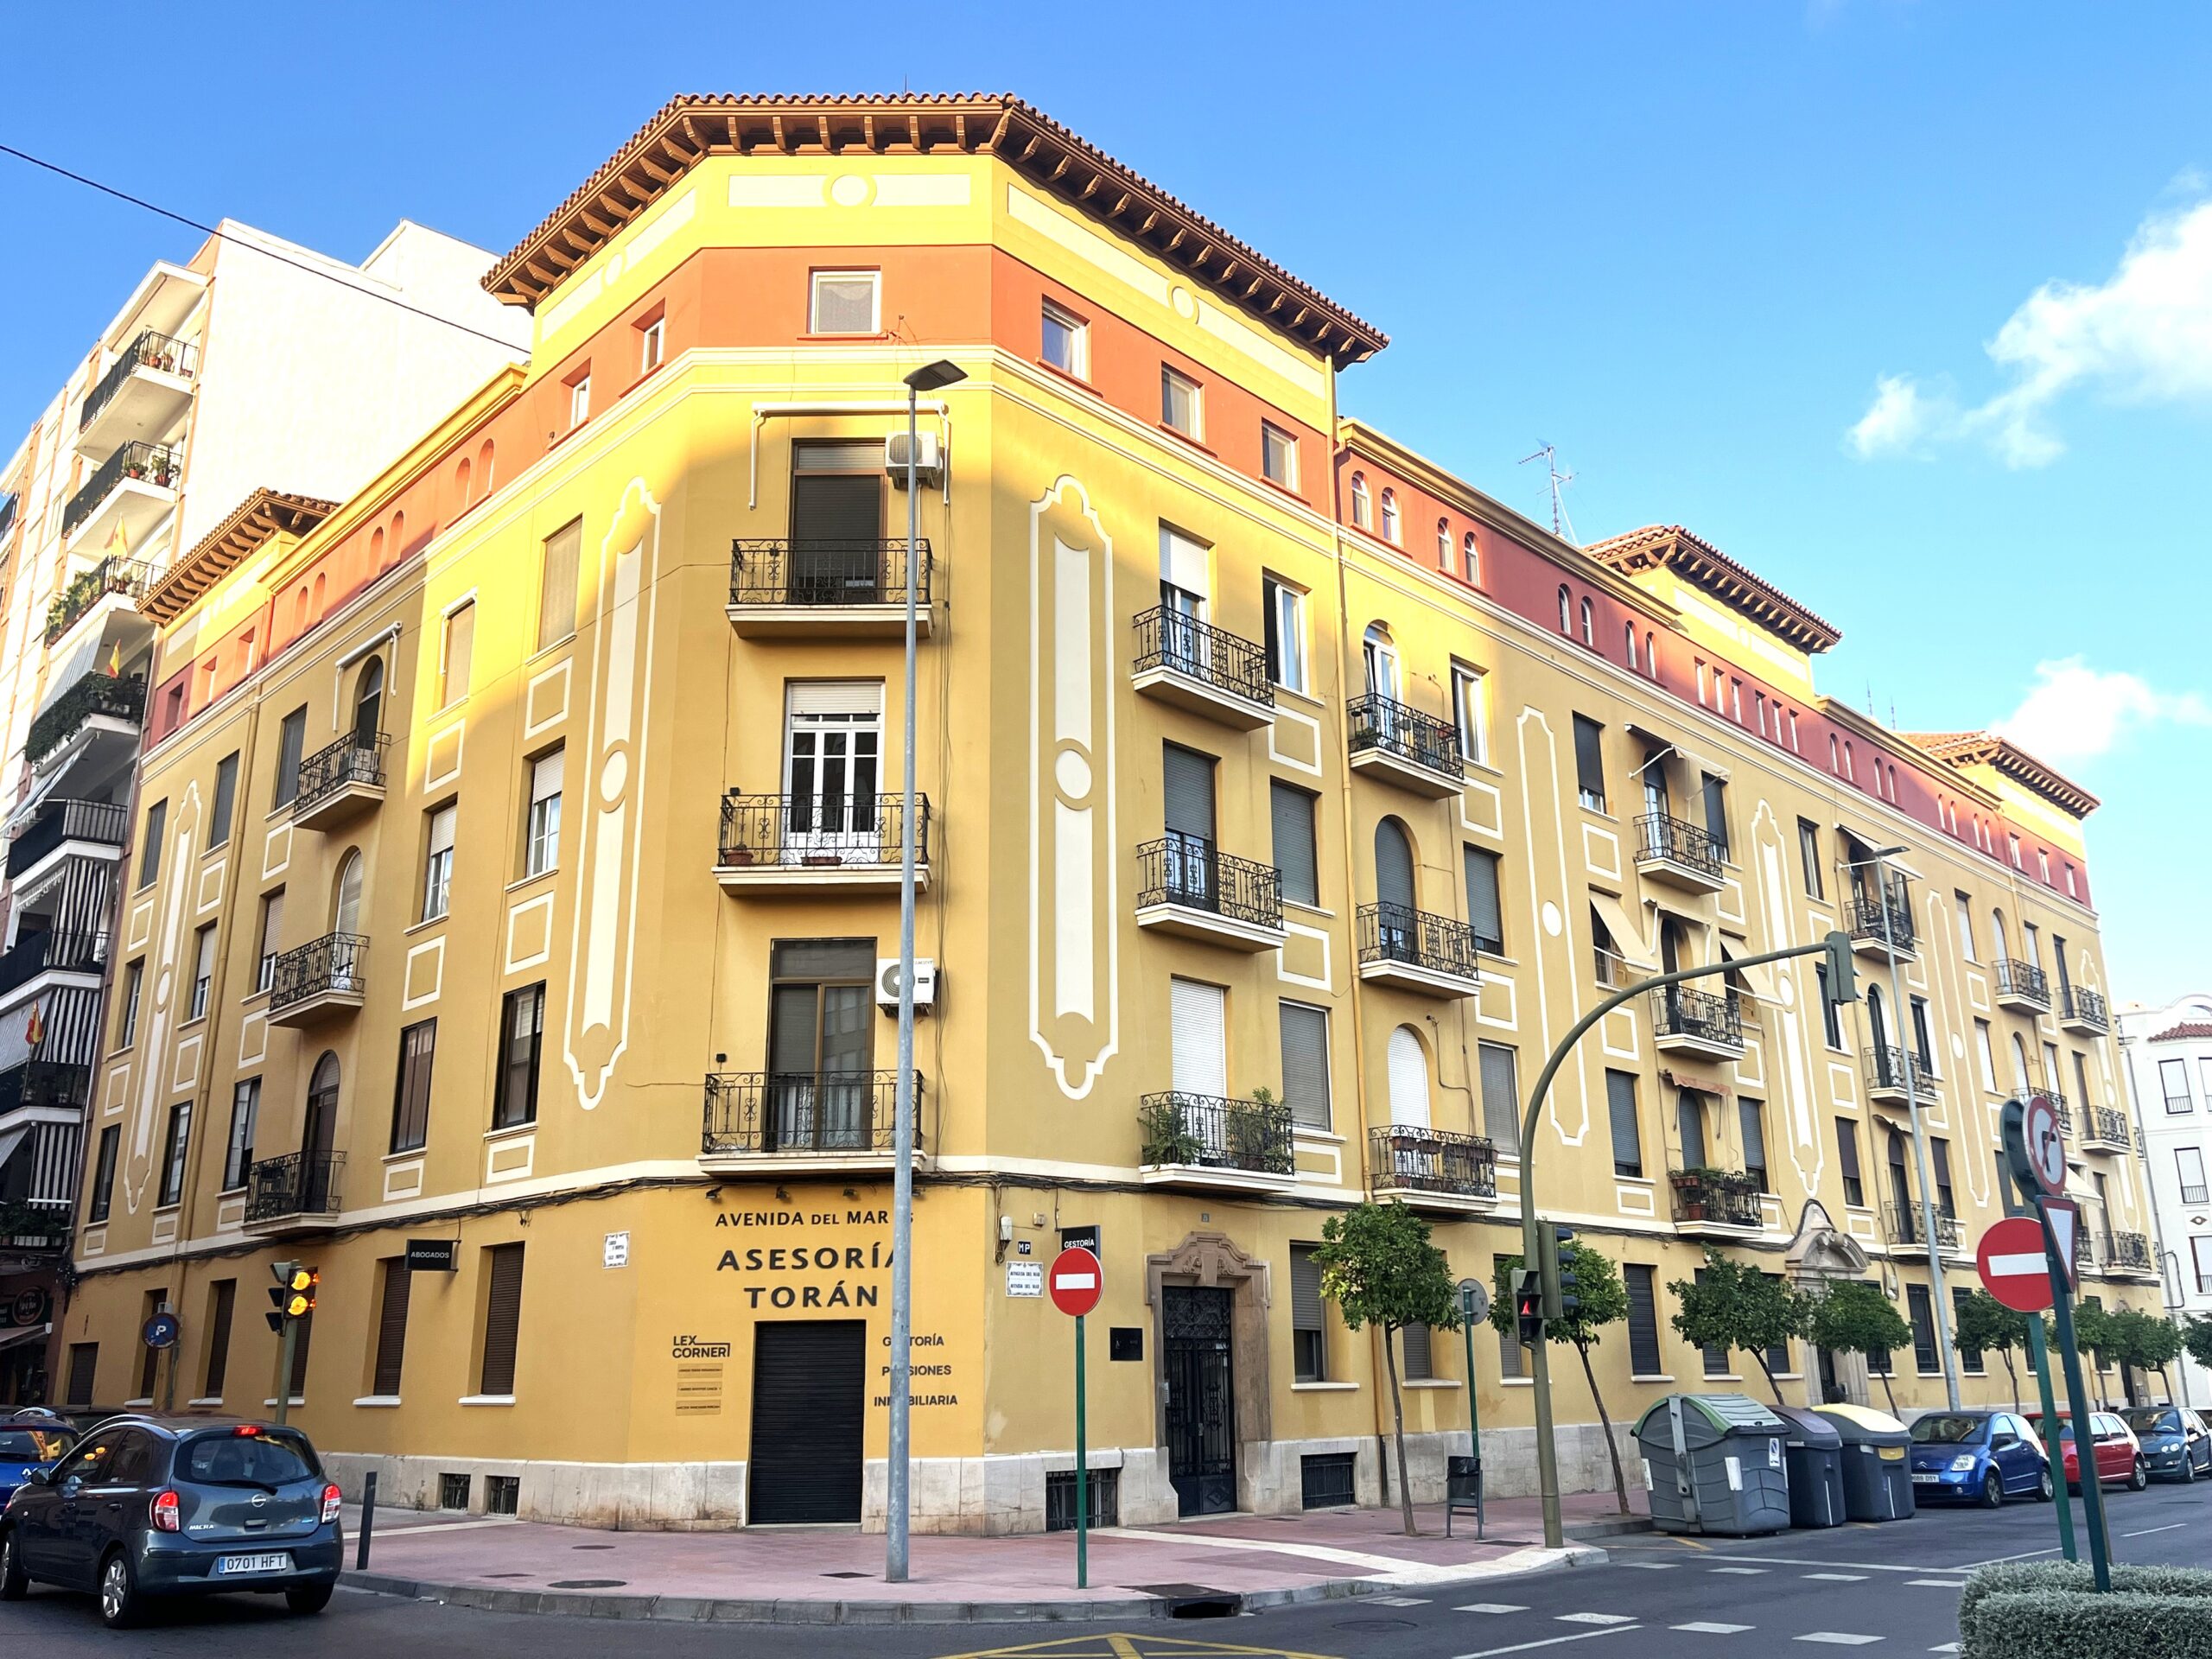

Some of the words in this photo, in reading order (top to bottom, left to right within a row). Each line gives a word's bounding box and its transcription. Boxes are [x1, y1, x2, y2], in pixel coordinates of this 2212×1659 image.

[715, 1211, 804, 1227] AVENIDA
[811, 1213, 840, 1225] DEL
[847, 1210, 889, 1224] MAR
[1018, 1243, 1031, 1253] MP
[1064, 1237, 1095, 1249] GESTORÍA
[744, 1280, 878, 1309] TORÁN
[673, 1335, 697, 1346] LEX
[882, 1332, 944, 1346] GTORÍA
[672, 1347, 727, 1358] CORNER
[881, 1364, 952, 1376] PSIONES
[874, 1395, 958, 1407] INBILIARIA
[226, 1557, 256, 1570] 0701
[261, 1555, 284, 1568] HFT
